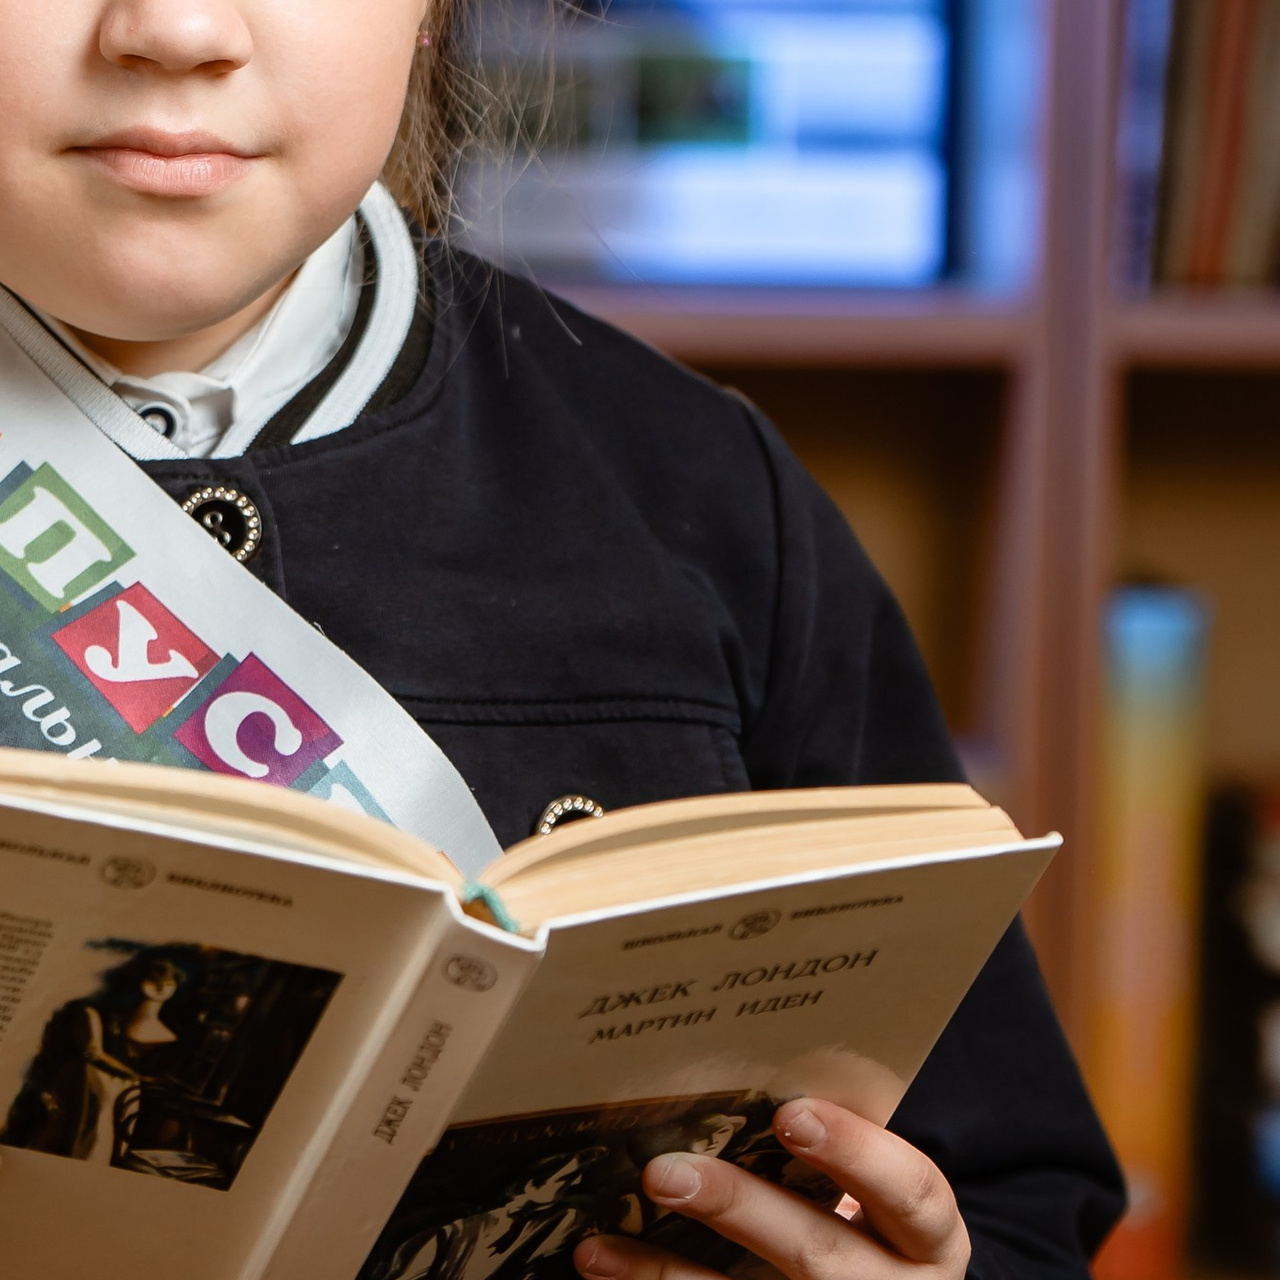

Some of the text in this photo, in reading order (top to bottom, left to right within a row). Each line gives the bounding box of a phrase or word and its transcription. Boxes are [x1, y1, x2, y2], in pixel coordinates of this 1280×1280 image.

[578, 949, 879, 1019] ДЖЕК ЛОНДОН
[588, 990, 825, 1045] МАРТИН ИДЕН
[372, 1020, 454, 1146] ДЖЕК ЛОНДОН
